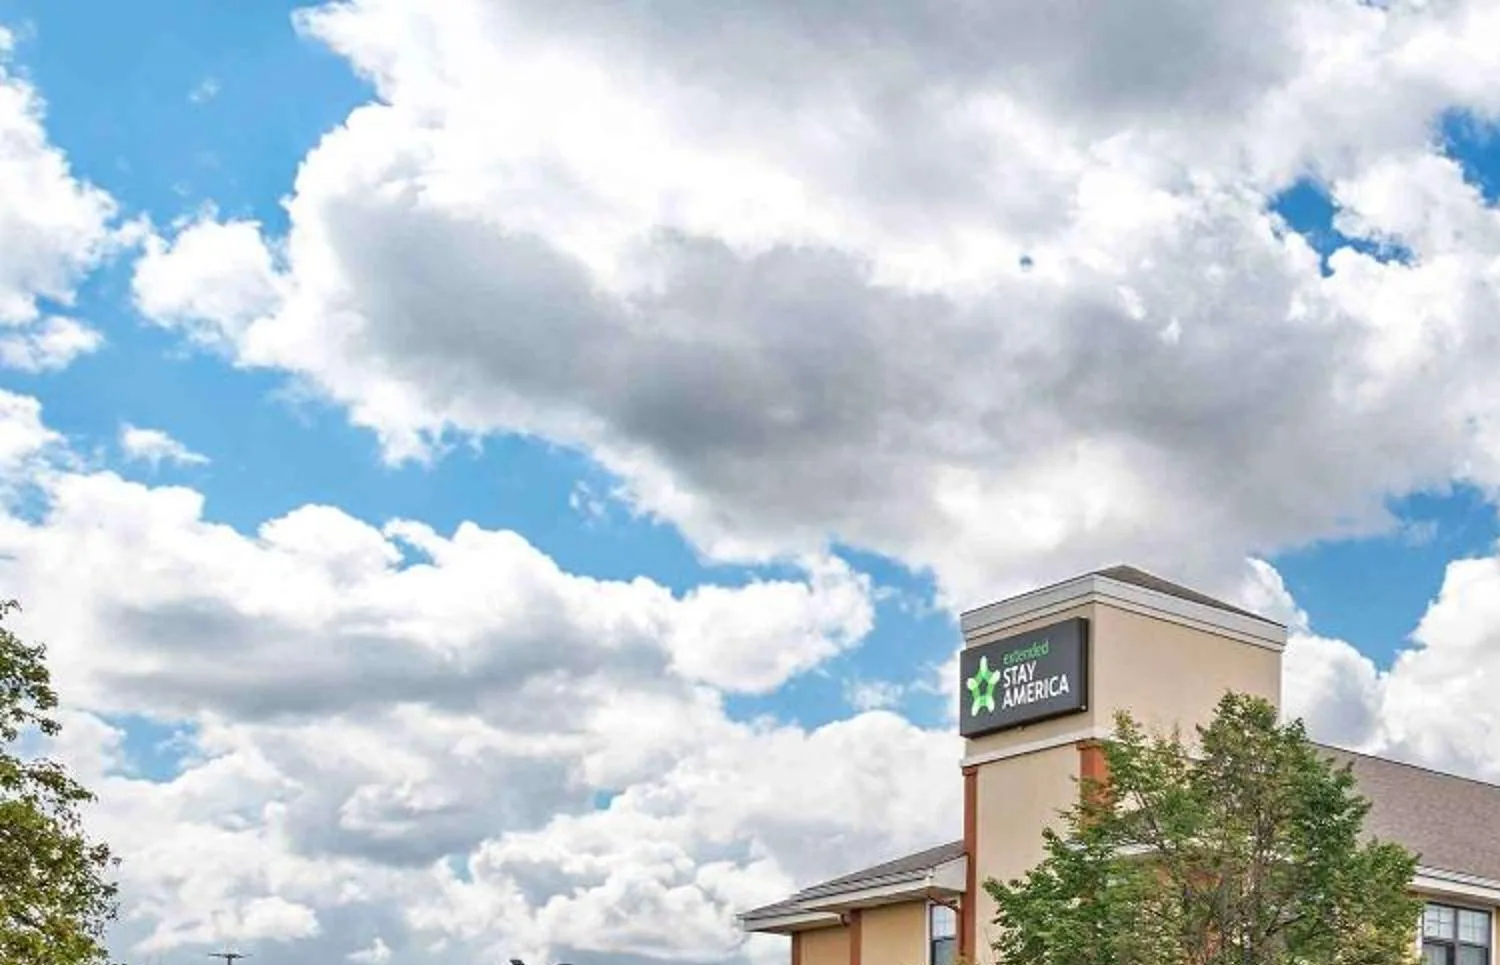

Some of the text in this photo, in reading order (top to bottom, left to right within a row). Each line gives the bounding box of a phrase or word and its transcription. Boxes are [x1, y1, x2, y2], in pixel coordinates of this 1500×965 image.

[1003, 640, 1049, 665] extended
[1003, 660, 1037, 688] STAY
[1002, 673, 1070, 709] AMERICA
